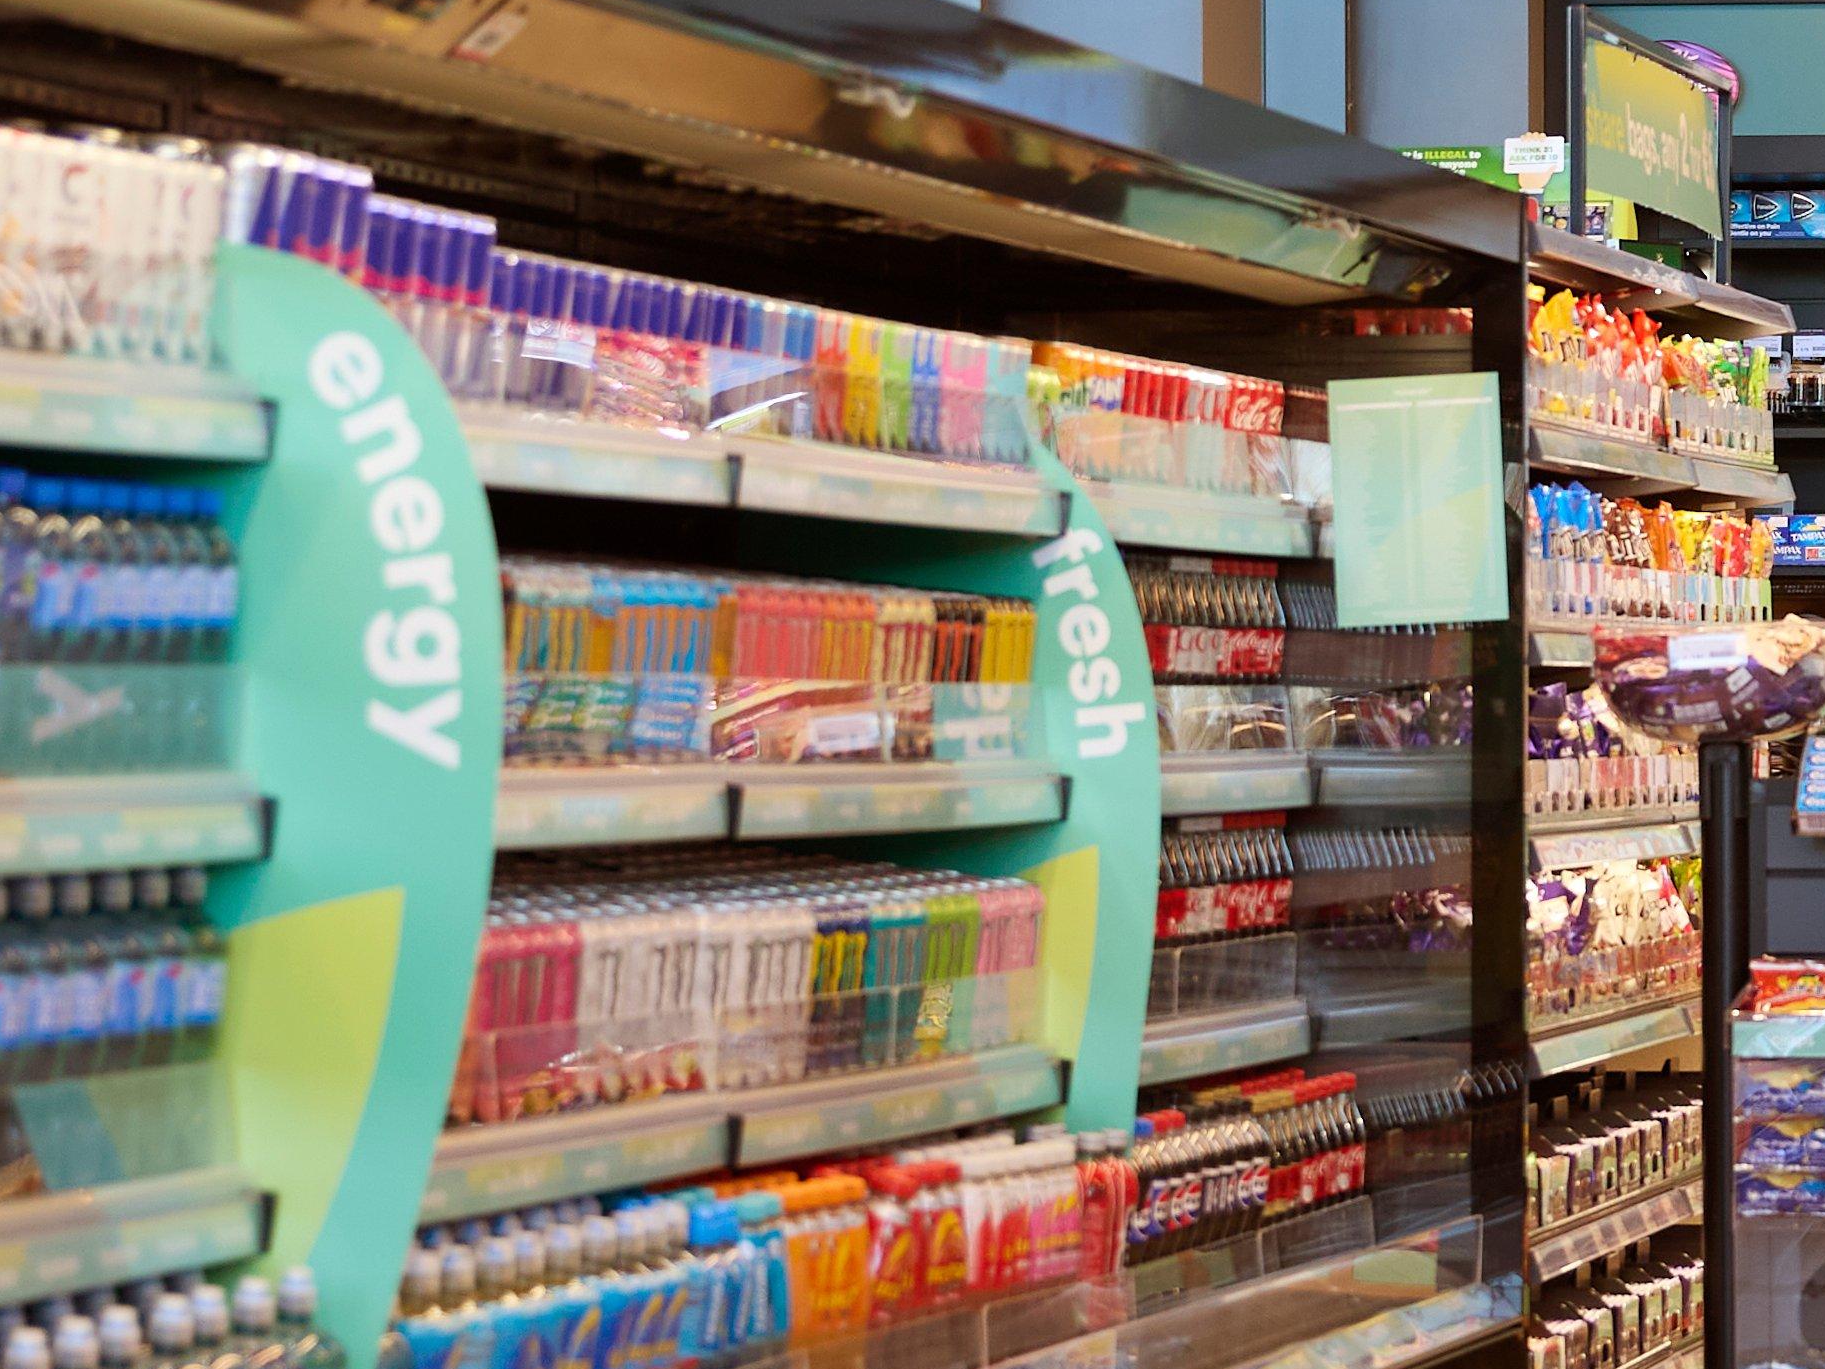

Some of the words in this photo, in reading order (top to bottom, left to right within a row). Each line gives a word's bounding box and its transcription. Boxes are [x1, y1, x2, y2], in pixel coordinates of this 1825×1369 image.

[1425, 151, 1467, 159] ILLEGAL
[1469, 151, 1481, 159] to
[308, 330, 462, 771] energy
[1031, 525, 1146, 763] fresh
